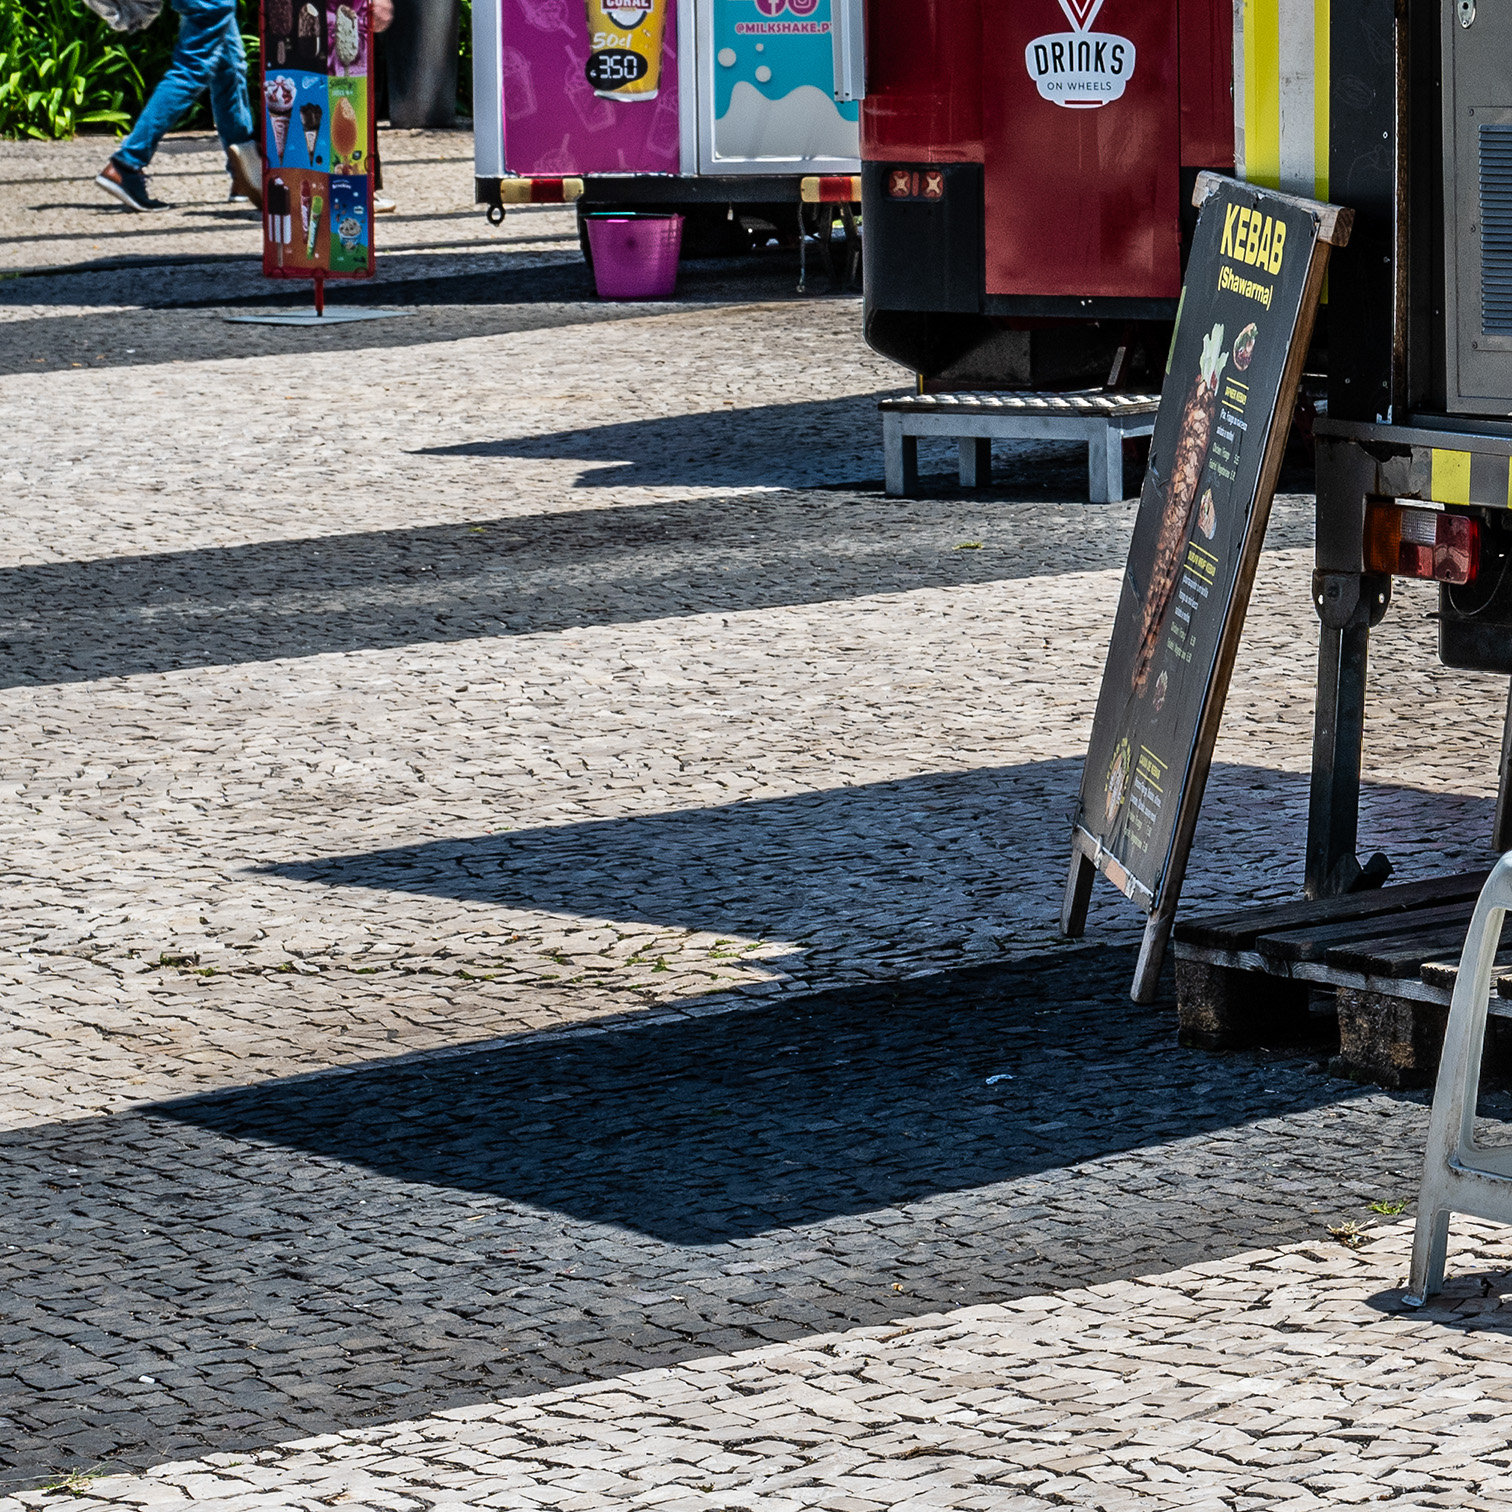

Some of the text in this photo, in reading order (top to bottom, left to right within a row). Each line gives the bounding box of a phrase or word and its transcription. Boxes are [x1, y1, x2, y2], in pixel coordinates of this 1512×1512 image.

[592, 32, 633, 49] 50cl
[1034, 40, 1125, 76] DRINKS
[1047, 81, 1112, 91] ON WHEELS
[1219, 202, 1287, 276] KEBAB
[1217, 265, 1274, 311] (Shawarma)
